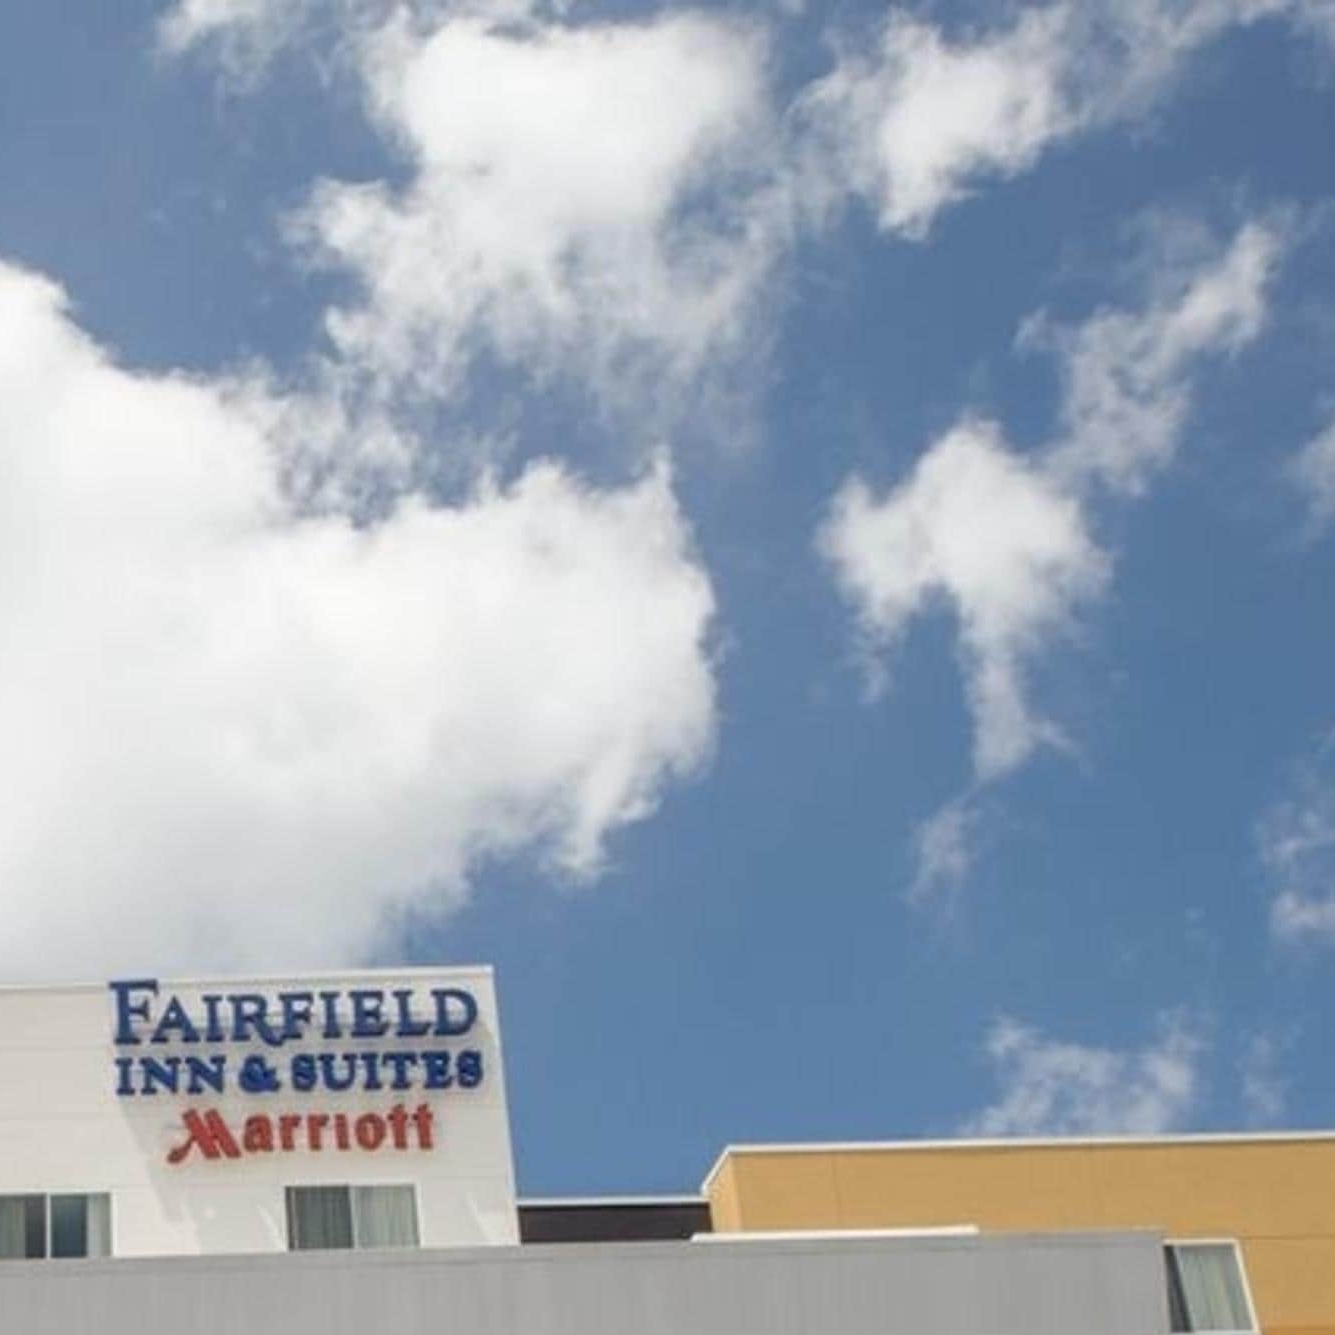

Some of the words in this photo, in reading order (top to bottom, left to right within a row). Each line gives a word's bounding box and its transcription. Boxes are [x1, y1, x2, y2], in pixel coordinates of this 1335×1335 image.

[109, 979, 479, 1046] FAIRFIELD
[115, 1056, 226, 1096] INN
[239, 1055, 281, 1093] &
[291, 1050, 483, 1092] SUITES
[167, 1103, 434, 1164] Marriott
